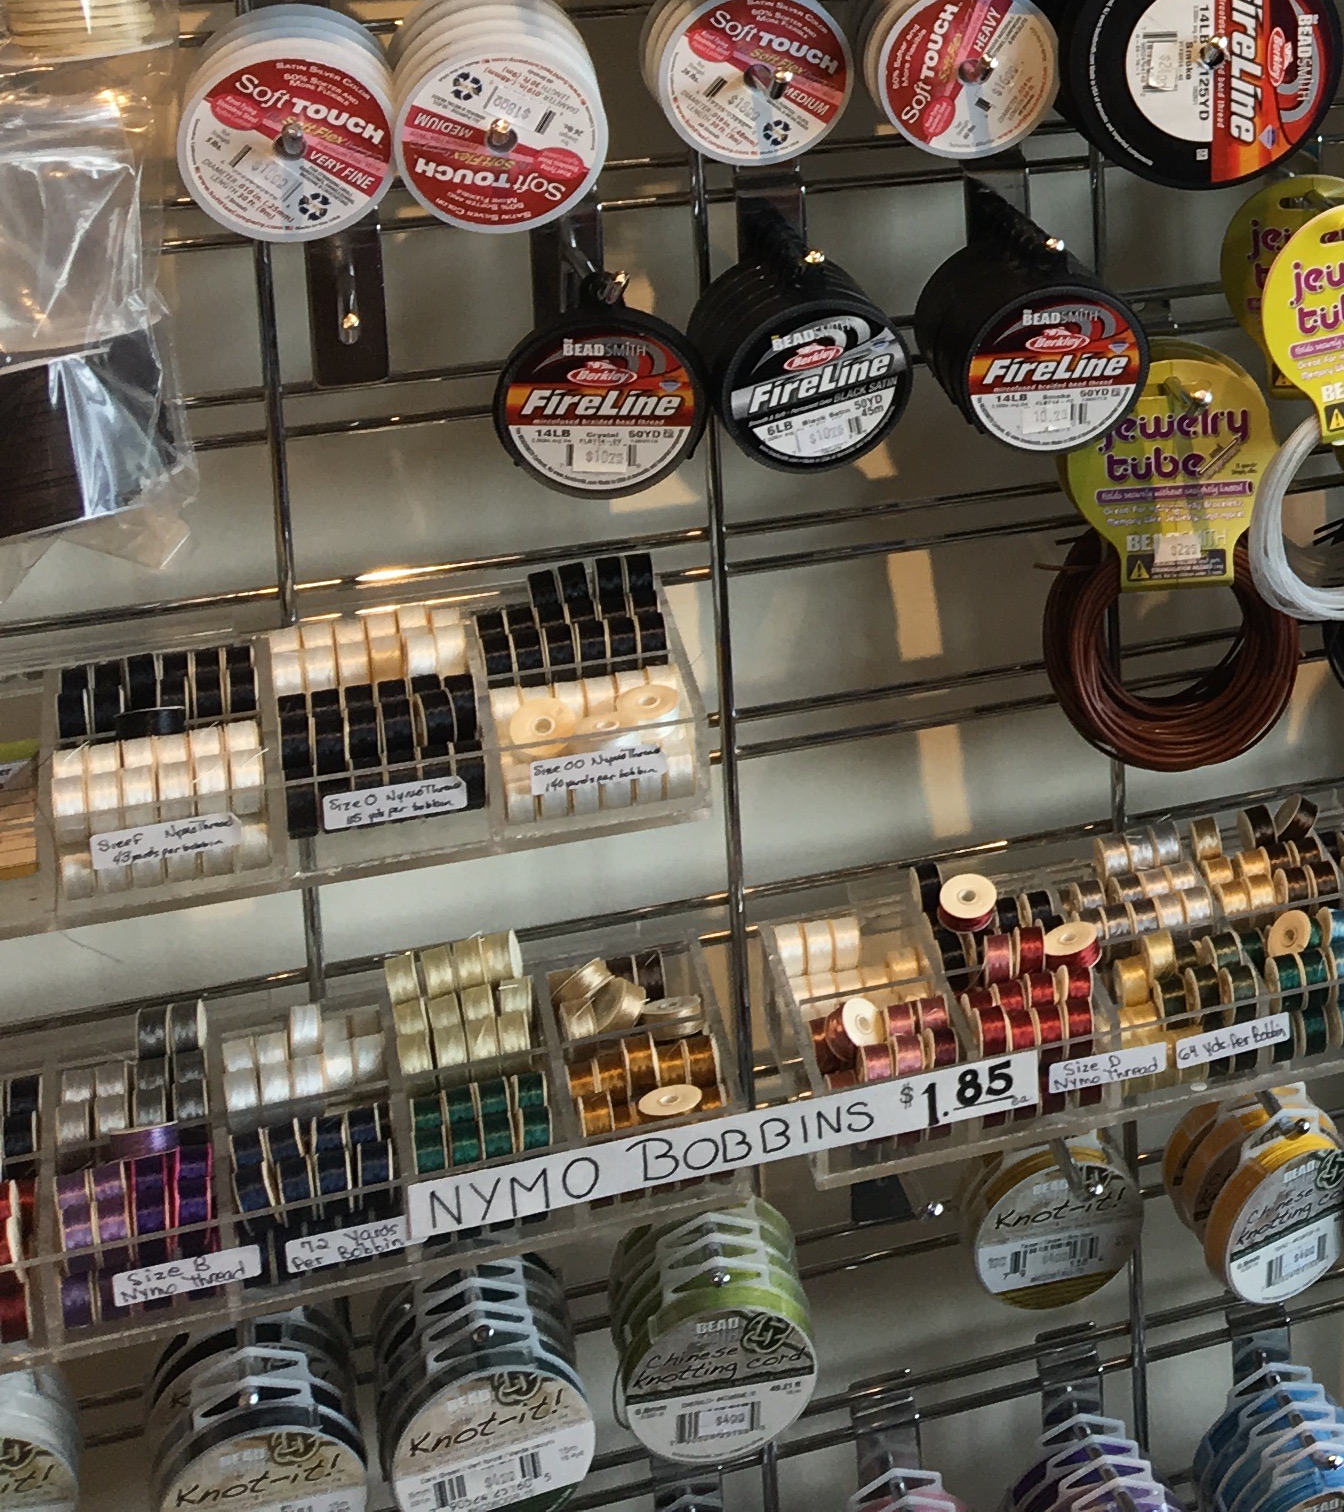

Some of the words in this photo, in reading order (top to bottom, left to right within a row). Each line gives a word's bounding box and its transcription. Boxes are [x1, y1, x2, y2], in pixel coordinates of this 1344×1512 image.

[921, 3, 958, 79] TOUCH
[973, 5, 999, 53] HEAVY
[236, 74, 287, 111] Soft
[287, 97, 385, 144] TOUCH
[414, 111, 475, 139] MEDIUM
[309, 150, 344, 176] VERY
[342, 164, 376, 190] FINE
[563, 342, 649, 358] BEADSMITH
[749, 355, 892, 414] FireLine
[834, 387, 866, 402] BLACK
[868, 376, 898, 393] SATIN
[521, 390, 681, 416] FireLine
[767, 419, 793, 434] 6LB
[854, 396, 883, 412] 50YD
[861, 406, 884, 419] 45m
[535, 428, 570, 439] 14LB
[1064, 1059, 1099, 1077] Size
[1108, 1054, 1121, 1070] D
[1053, 1075, 1100, 1092] Nymo
[430, 1156, 600, 1230] NYMO
[627, 1101, 875, 1184] BOBBINS
[301, 1239, 330, 1254] 72
[127, 1266, 183, 1287] Size
[121, 1283, 178, 1304] Nymo
[646, 1346, 738, 1369] Chinese
[632, 1361, 738, 1388] knotting
[406, 1388, 566, 1456] Knot-it!
